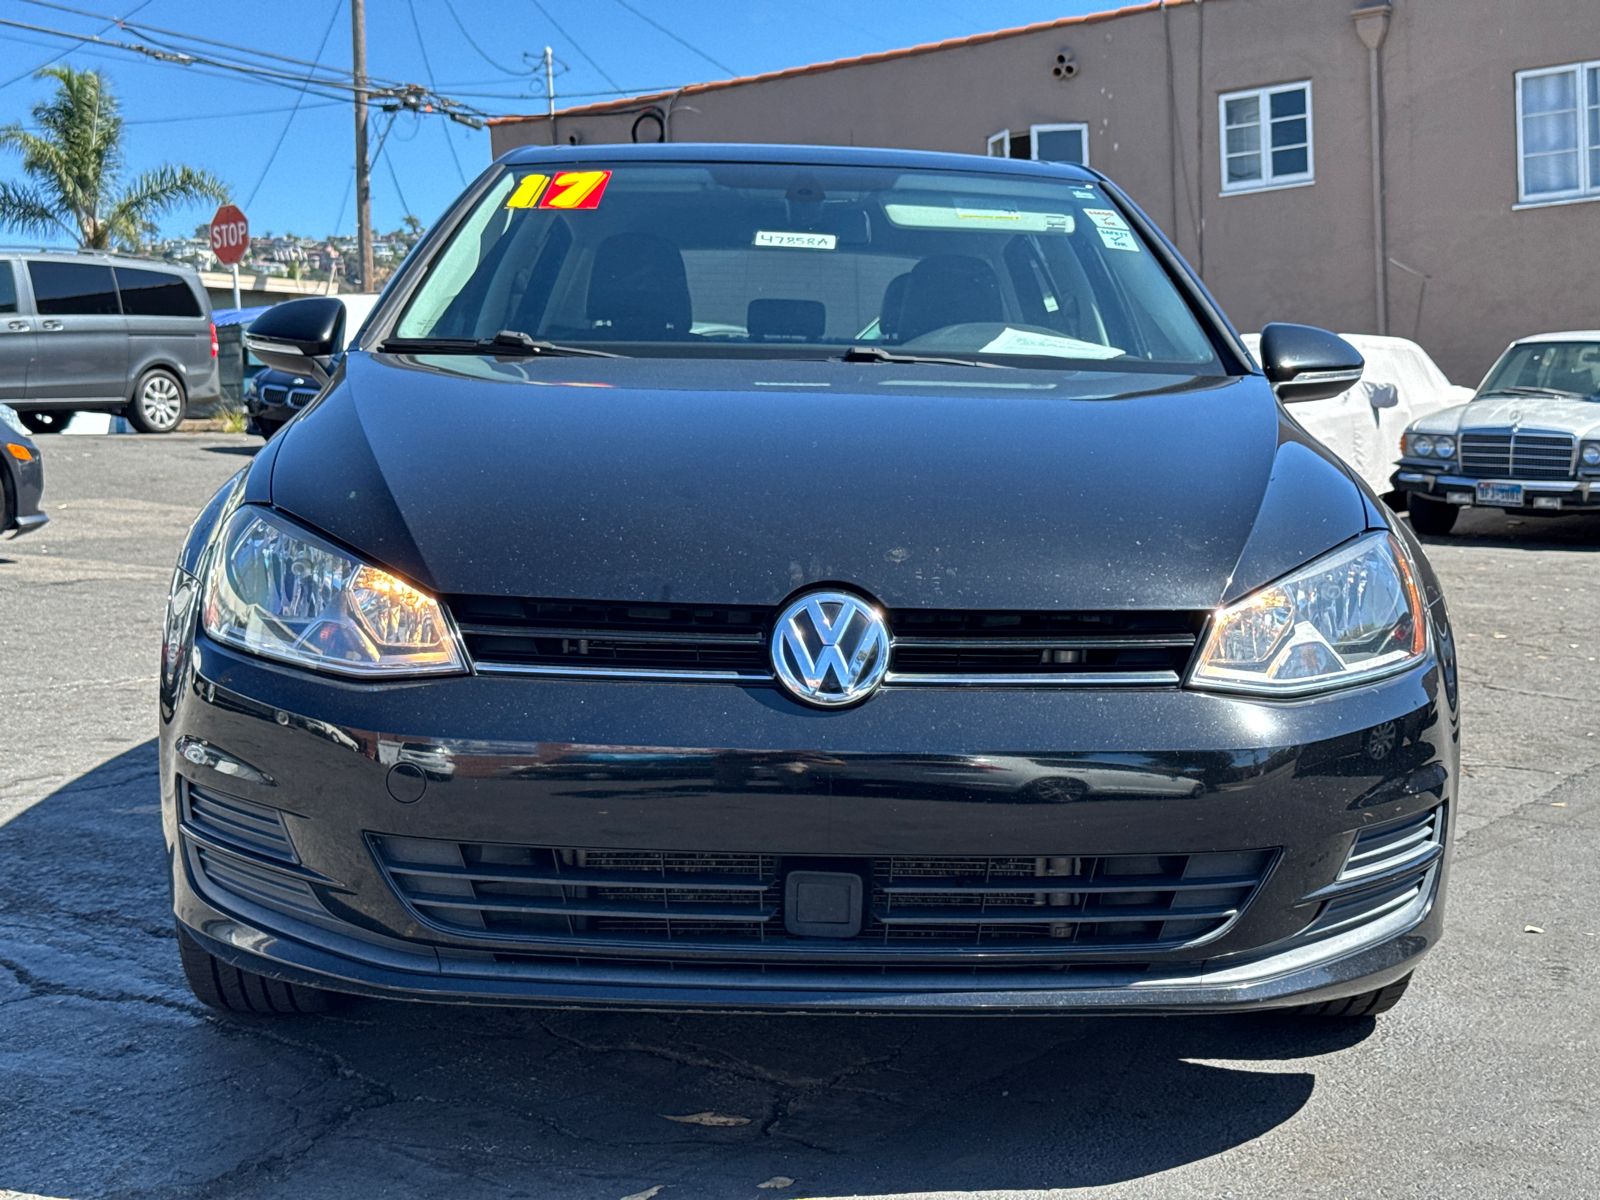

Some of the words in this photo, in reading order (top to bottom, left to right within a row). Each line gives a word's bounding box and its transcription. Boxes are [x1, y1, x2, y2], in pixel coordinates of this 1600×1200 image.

[506, 170, 608, 209] 17
[212, 222, 247, 249] STOP
[779, 596, 882, 698] VW
